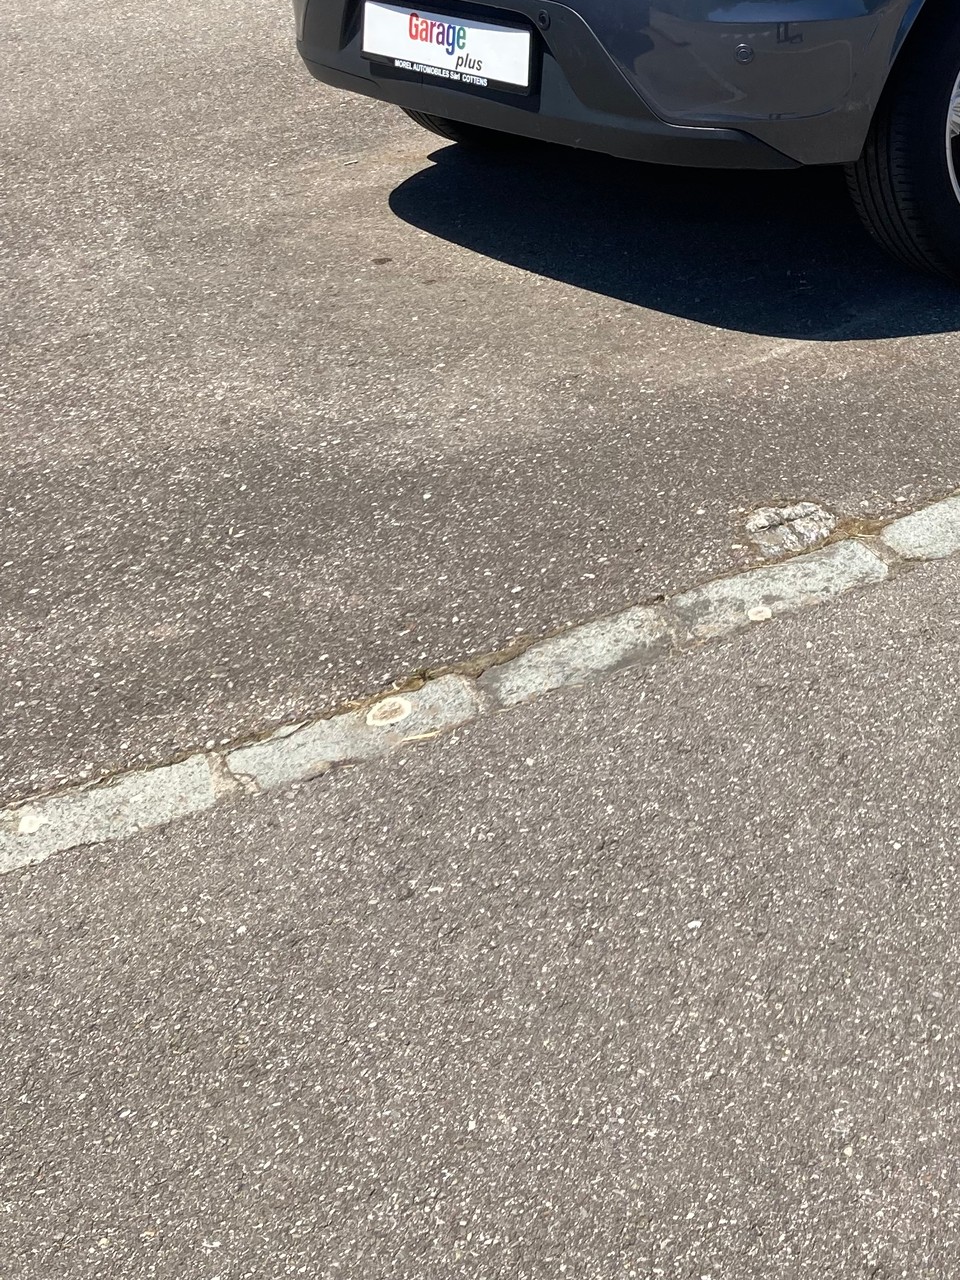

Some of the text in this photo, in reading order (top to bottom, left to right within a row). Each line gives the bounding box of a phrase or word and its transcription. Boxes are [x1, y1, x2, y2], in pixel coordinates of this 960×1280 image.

[409, 12, 466, 55] Garage
[395, 59, 412, 70] MOREL
[413, 63, 450, 78] AUTOMOBILES
[462, 75, 488, 86] COTTENS
[455, 53, 483, 71] plus
